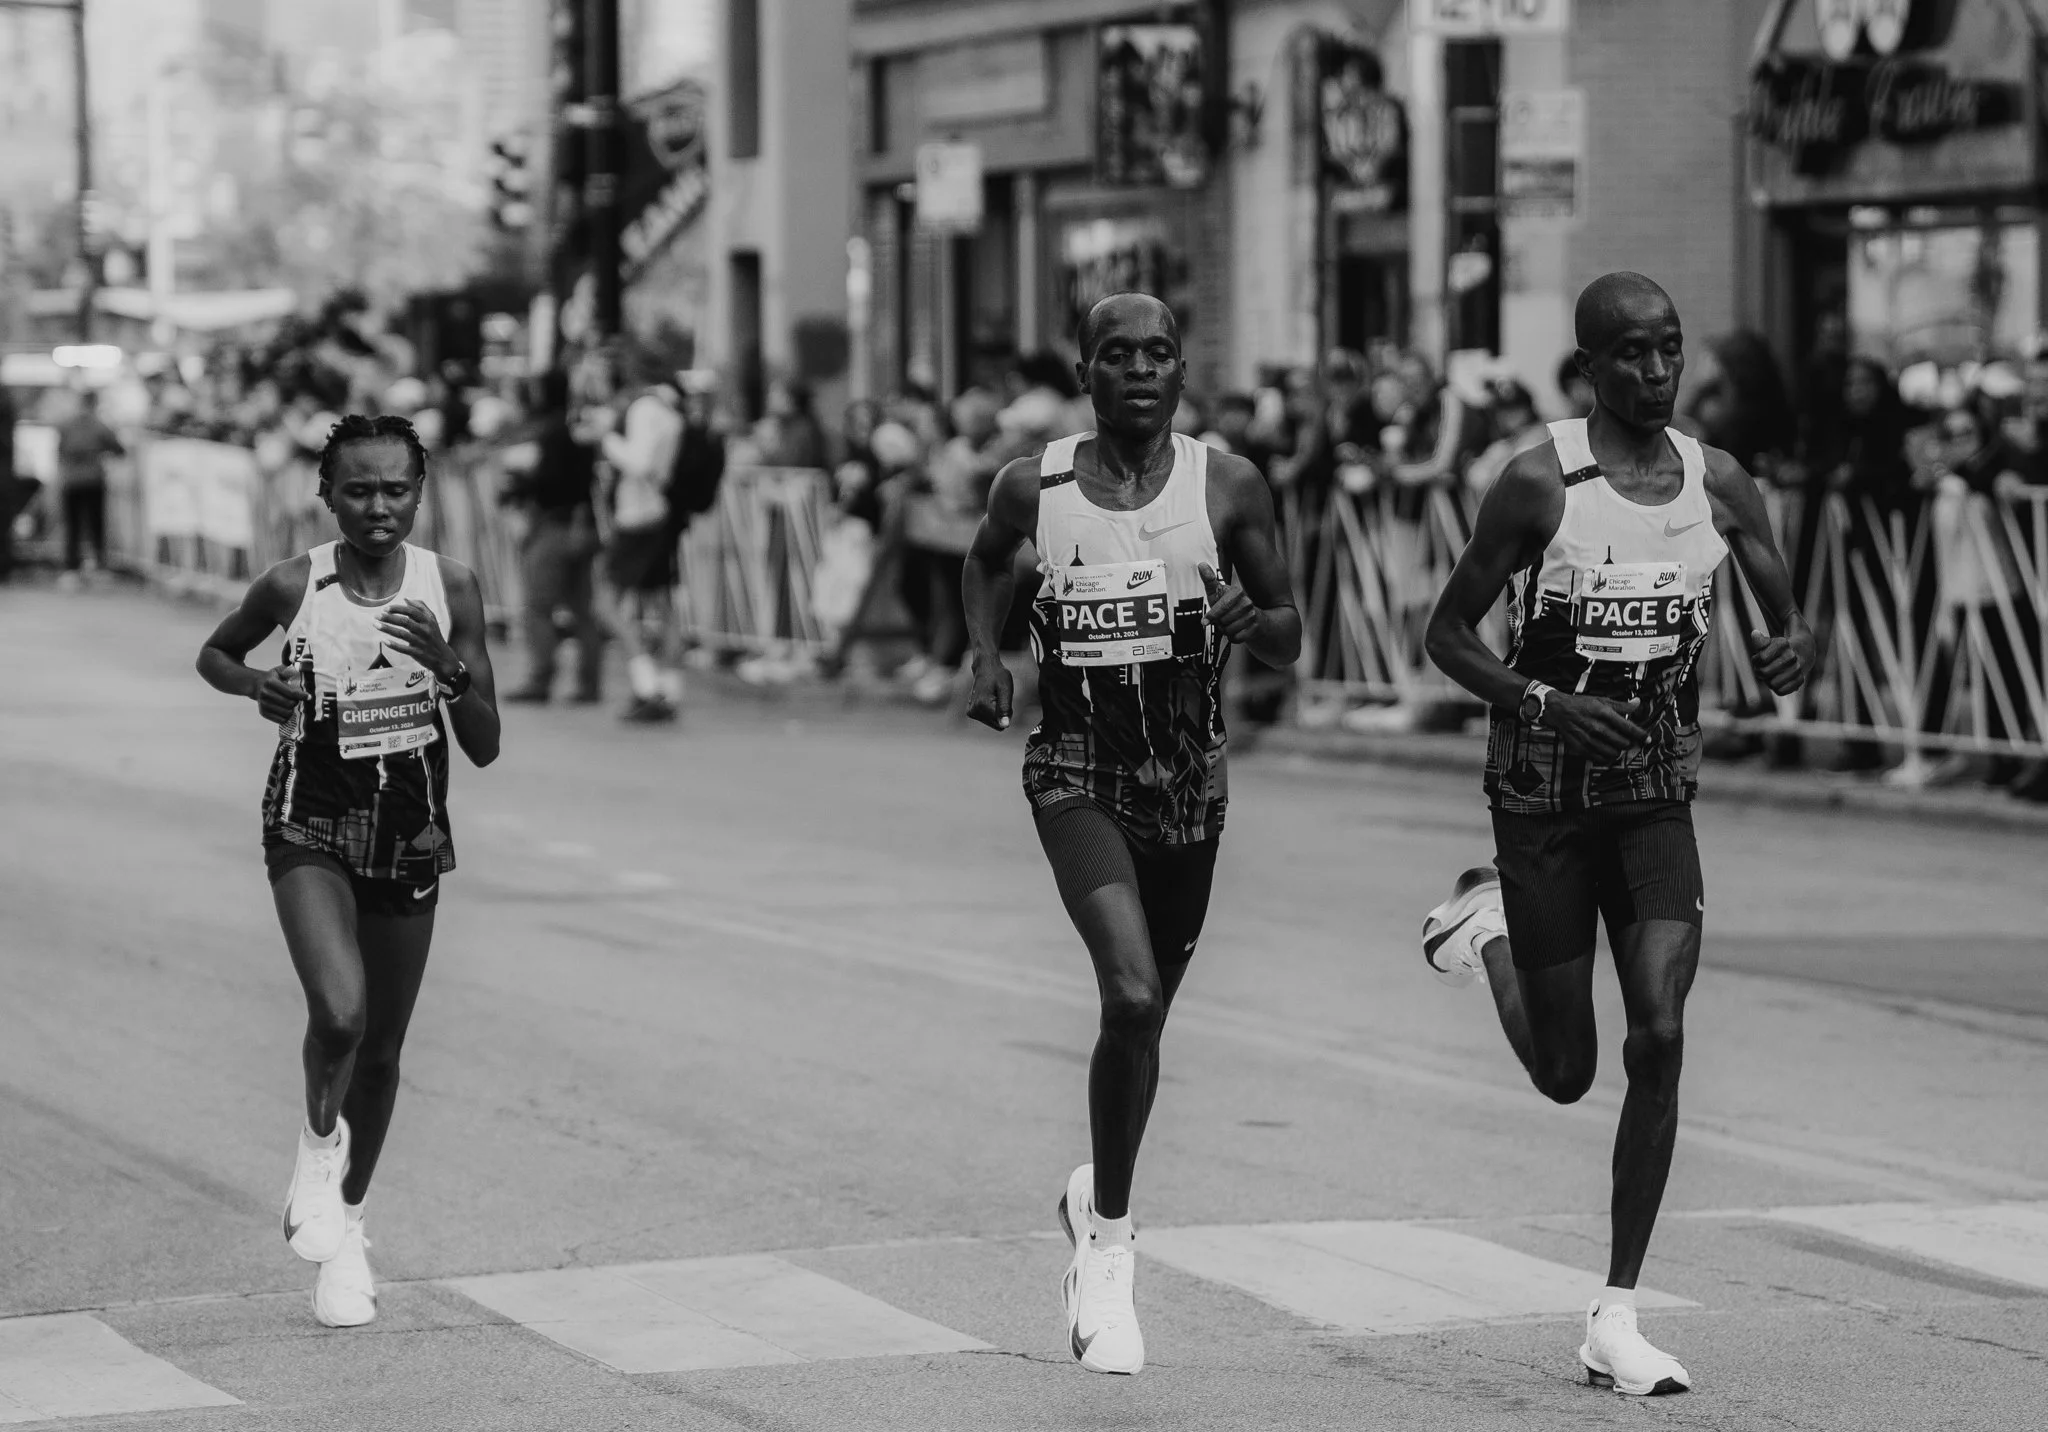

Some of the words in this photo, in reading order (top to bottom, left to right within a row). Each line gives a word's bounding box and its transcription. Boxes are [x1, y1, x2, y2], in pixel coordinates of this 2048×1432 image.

[1132, 570, 1153, 581] RUN
[1659, 572, 1678, 581] RUN
[1075, 580, 1100, 588] Chicago
[1062, 601, 1137, 630] PACE
[1147, 598, 1166, 624] 5
[1585, 601, 1658, 626] PACE
[1666, 599, 1681, 624] 6
[1123, 630, 1139, 638] 2024
[1634, 629, 1643, 637] 13,
[410, 670, 426, 681] RUN
[342, 698, 436, 723] CHEPNGETICH
[369, 725, 391, 733] October
[391, 723, 400, 731] 13,
